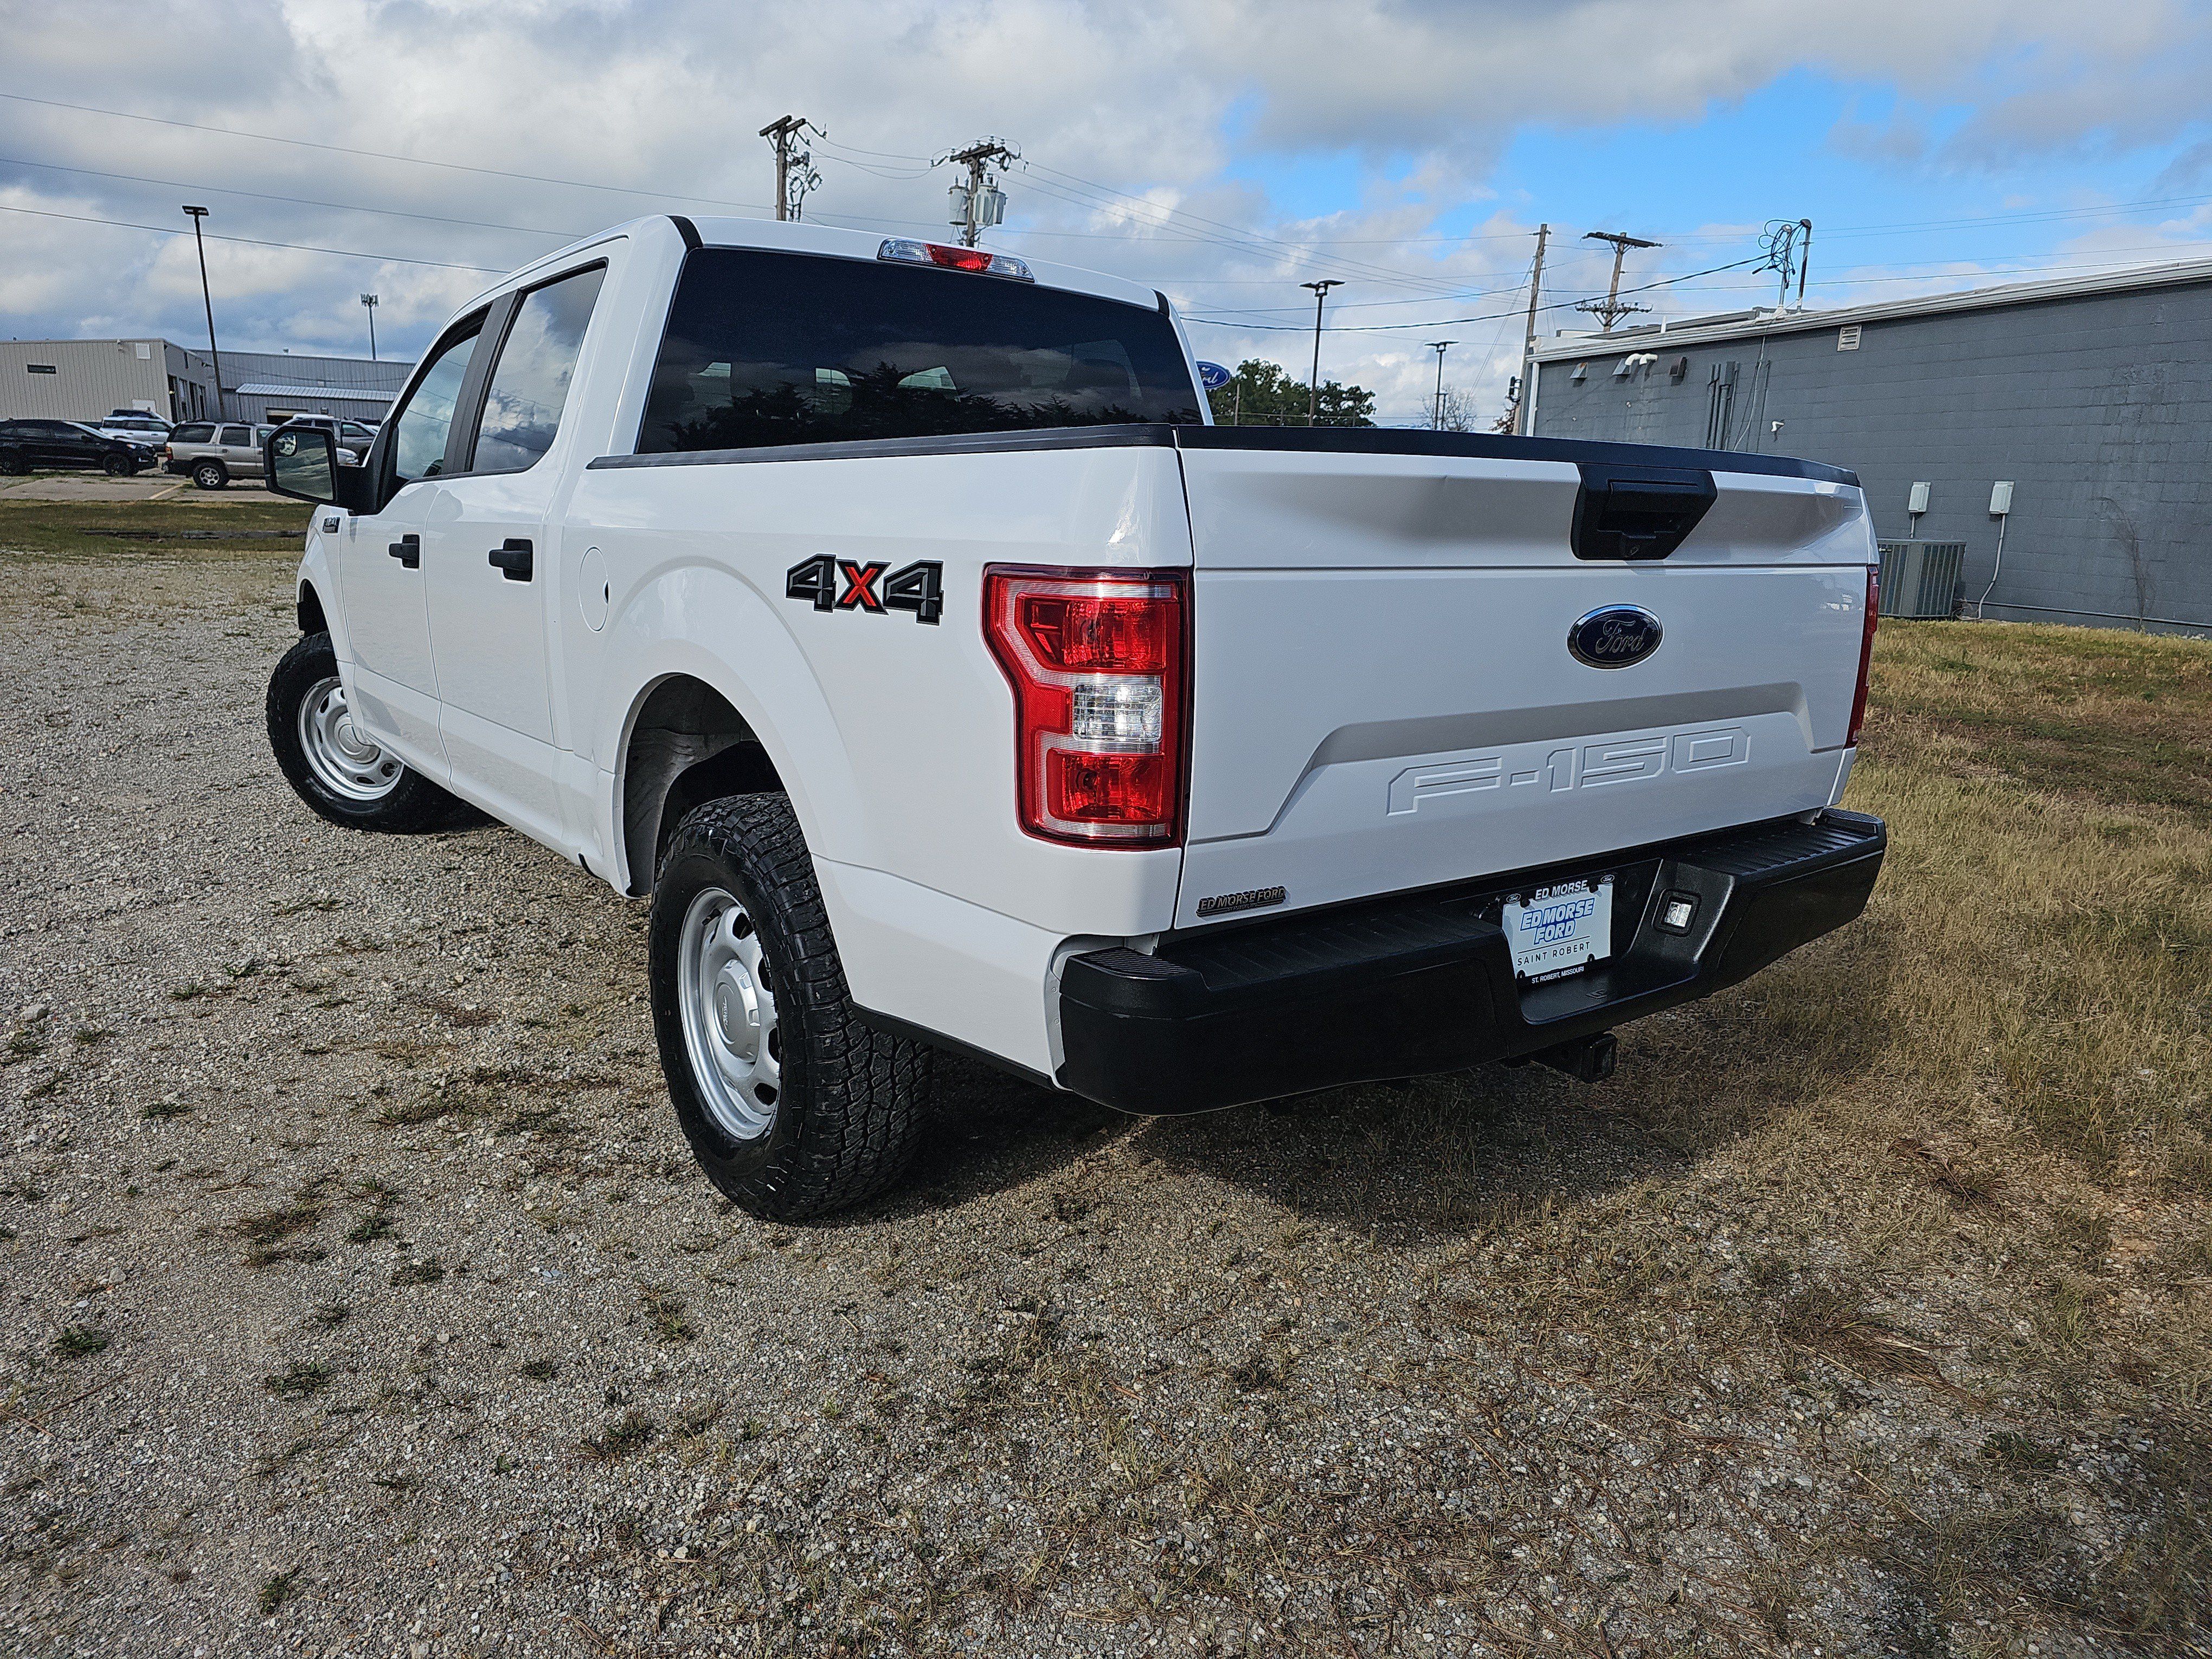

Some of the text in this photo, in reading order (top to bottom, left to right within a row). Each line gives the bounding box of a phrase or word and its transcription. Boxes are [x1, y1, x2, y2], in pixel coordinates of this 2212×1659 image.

[1595, 619, 1647, 654] Ford
[1386, 726, 1751, 816] F-150
[1200, 898, 1216, 910] ED
[1217, 891, 1256, 908] MORSE
[1256, 886, 1287, 902] FORD
[1535, 879, 1588, 900] ED MORSE
[1520, 898, 1594, 931] ED MORSE
[1534, 921, 1577, 945] FORD
[1517, 942, 1590, 966] SAINT ROBERT
[1561, 966, 1584, 978] MISSOURI
